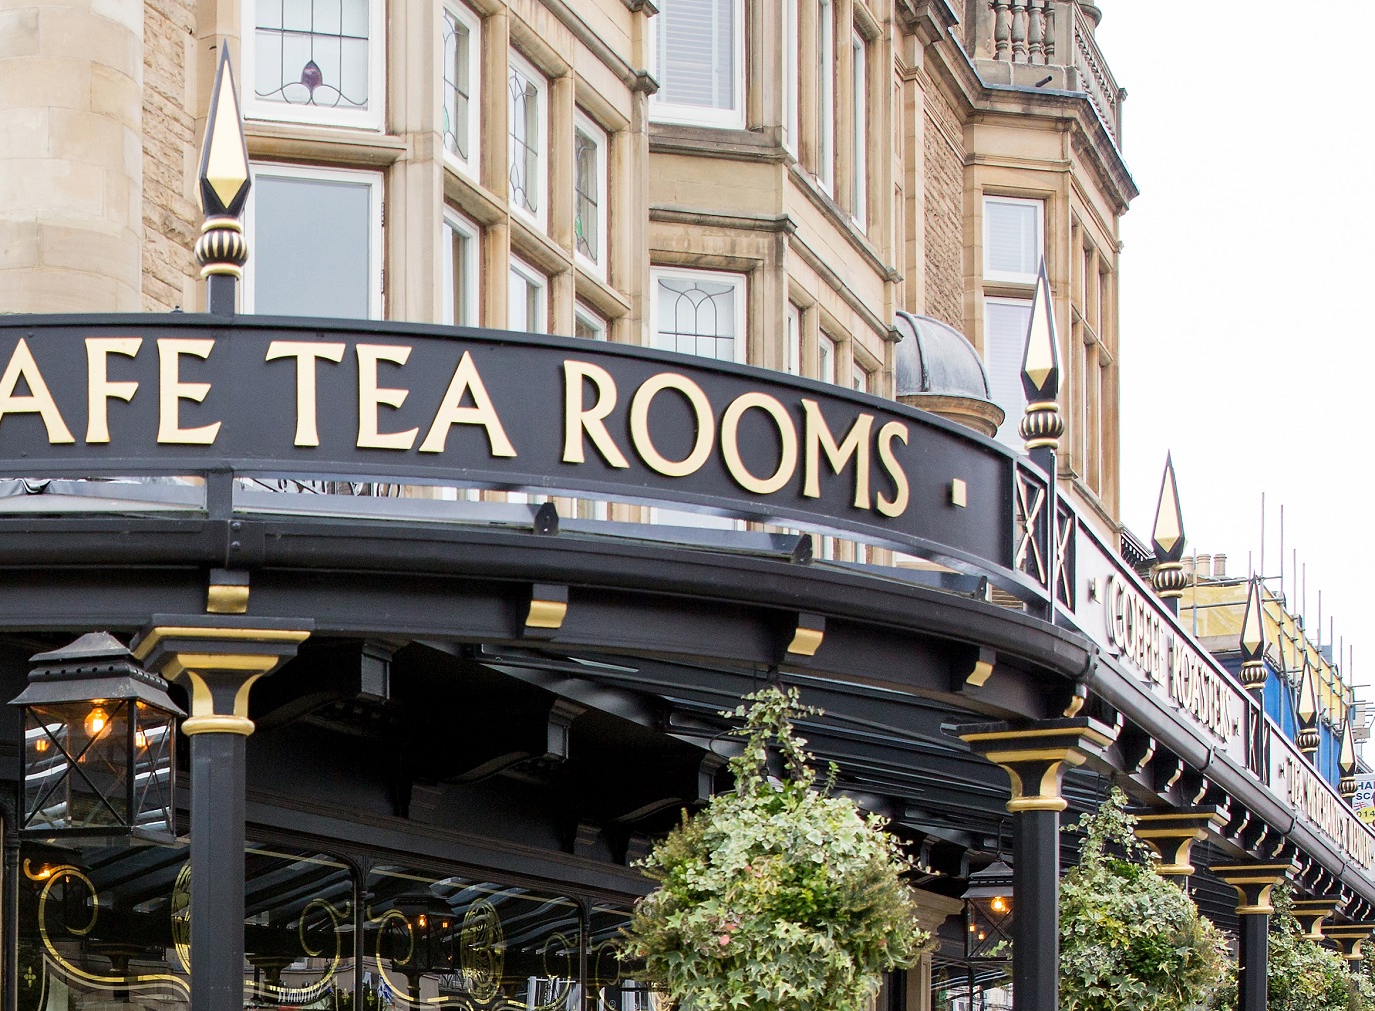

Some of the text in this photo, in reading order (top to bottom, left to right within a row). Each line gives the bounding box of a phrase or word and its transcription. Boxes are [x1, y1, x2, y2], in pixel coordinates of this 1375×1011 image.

[265, 340, 517, 458] TEA
[562, 359, 910, 518] ROOMS
[1111, 571, 1233, 744] COFFEE ROASTERS
